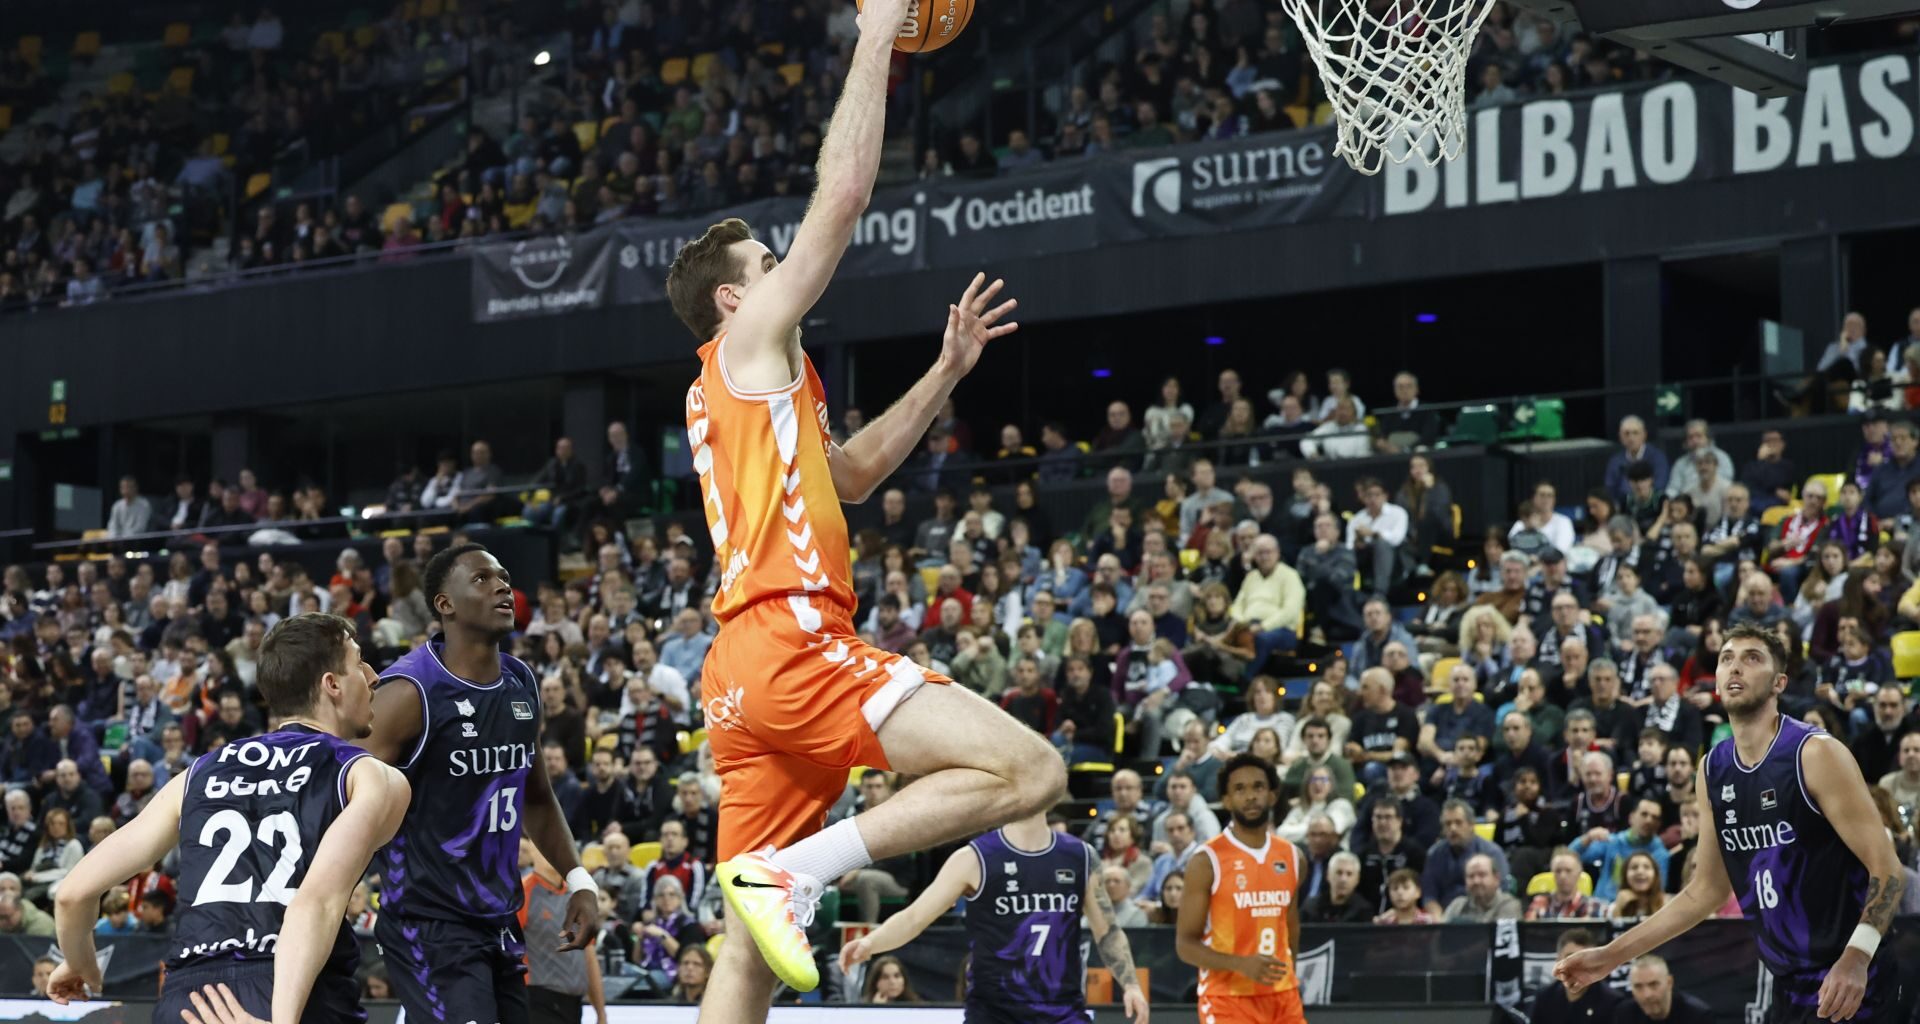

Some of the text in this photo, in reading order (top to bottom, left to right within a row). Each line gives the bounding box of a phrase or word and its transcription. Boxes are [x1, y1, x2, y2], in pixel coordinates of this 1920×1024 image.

[1384, 54, 1920, 215] BILBAO BAS
[1191, 142, 1324, 190] surne
[965, 183, 1094, 229] Occident
[510, 248, 572, 268] NISSAN
[217, 741, 321, 771] FONT
[487, 786, 518, 833] 13
[1720, 820, 1796, 852] surne
[190, 808, 303, 907] 22
[995, 892, 1079, 916] surne
[1755, 868, 1779, 910] 18
[1030, 924, 1051, 957] 7
[1257, 927, 1276, 956] 8
